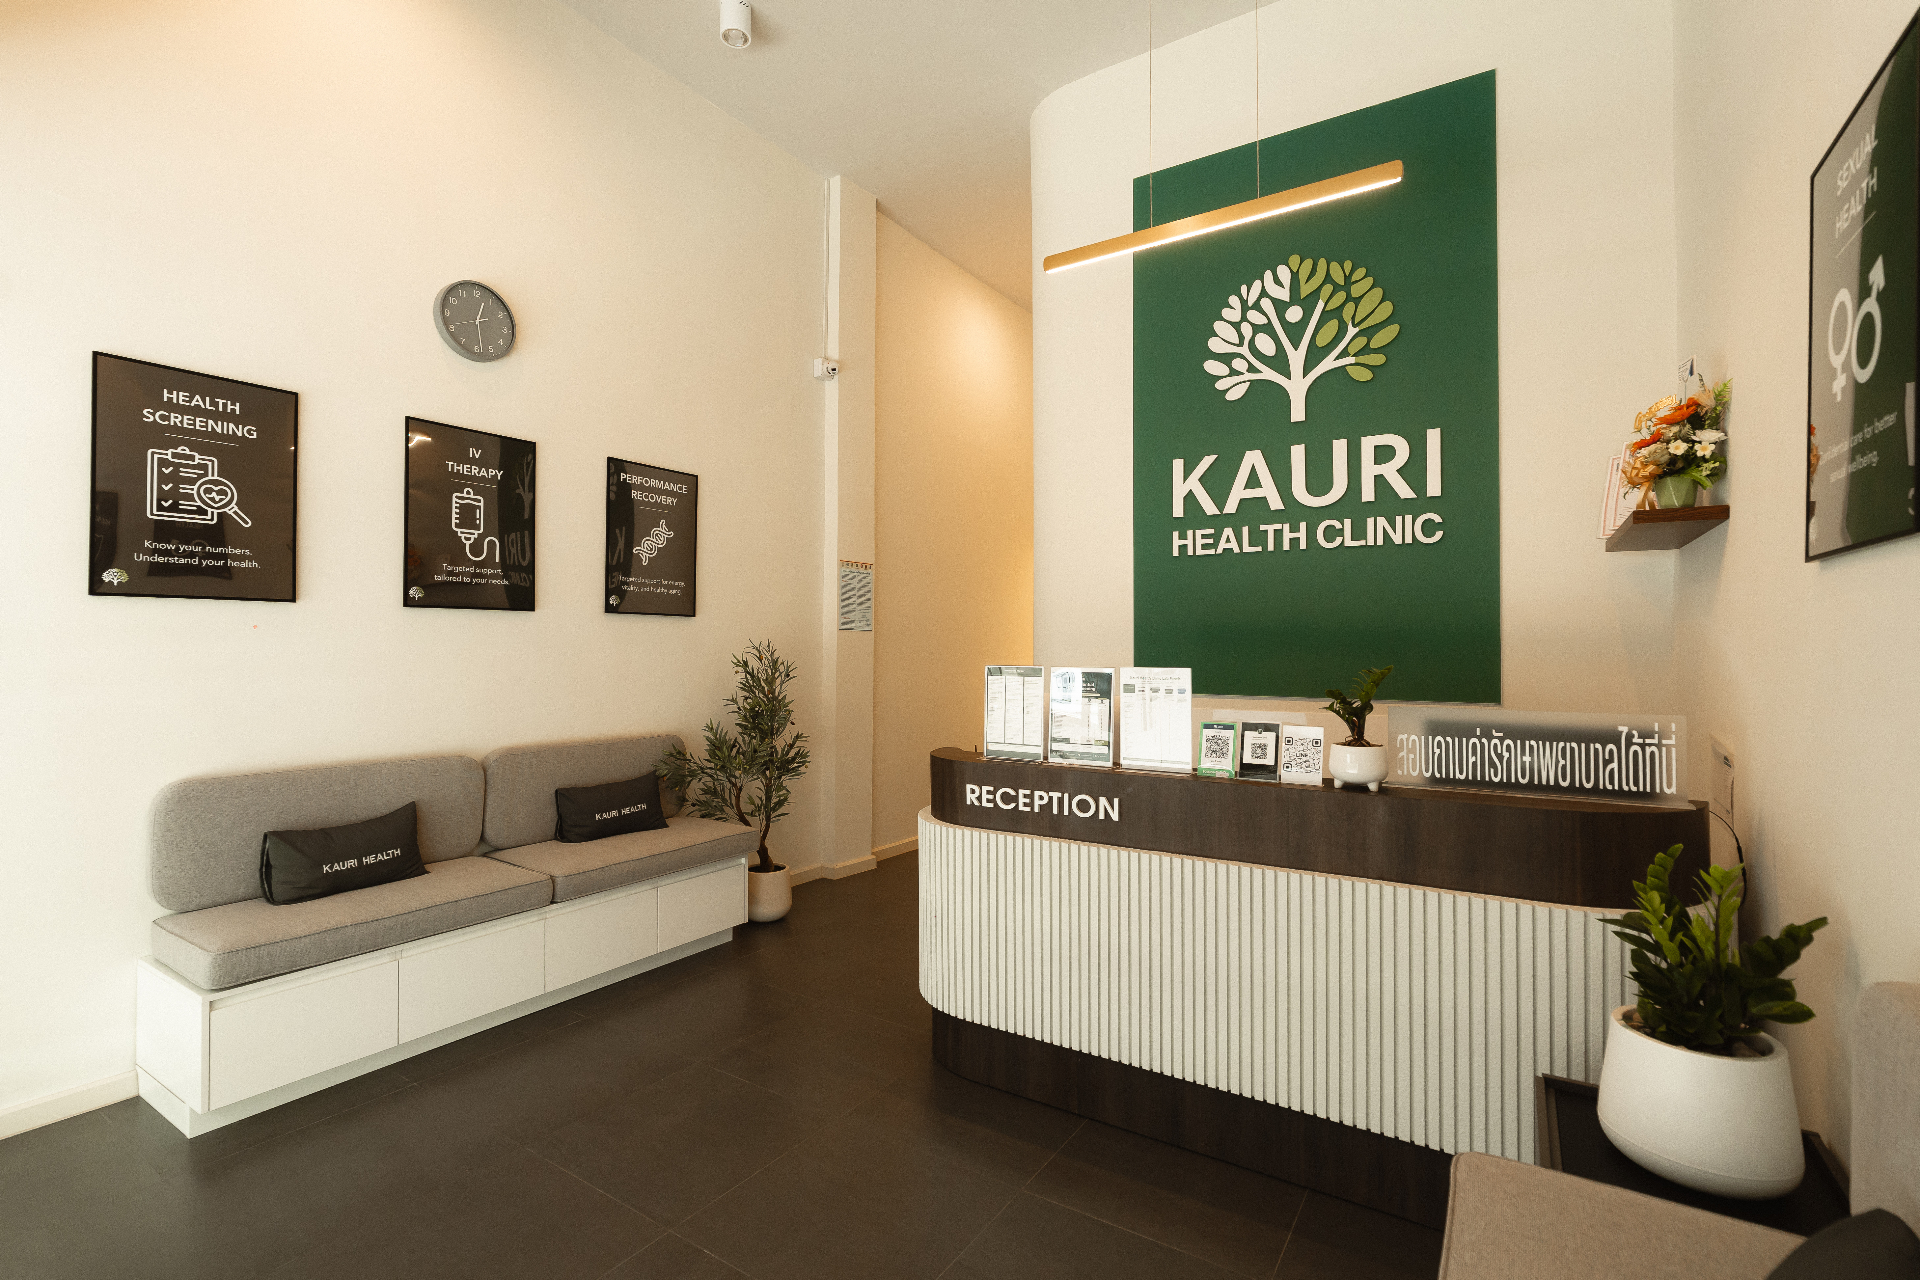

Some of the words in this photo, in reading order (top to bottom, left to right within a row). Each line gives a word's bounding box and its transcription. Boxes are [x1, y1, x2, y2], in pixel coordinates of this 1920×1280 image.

[1836, 123, 1878, 197] SEXUAL
[1835, 166, 1877, 239] HEALTH
[163, 388, 240, 415] HEALTH
[142, 408, 258, 439] SCREENING
[469, 447, 482, 459] IV
[446, 461, 504, 481] THERAPY
[620, 472, 688, 494] PERFORMANCE
[1172, 427, 1442, 518] KAURI
[631, 489, 678, 506] RECOVERY
[1172, 521, 1307, 557] HEALTH
[1316, 512, 1444, 549] CLINIC
[144, 539, 176, 551] Know
[178, 543, 203, 553] your
[205, 545, 253, 556] numbers.
[134, 553, 199, 565] Understand
[201, 558, 225, 568] your
[227, 558, 261, 569] health.
[442, 563, 475, 573] Targeted
[475, 567, 504, 576] support,
[434, 573, 462, 582] tailored
[1396, 722, 1677, 795] สอบถามค่ารักษาพยาบาลได้ที่นี่
[595, 809, 619, 821] KAURI
[621, 802, 647, 816] HEALTH
[965, 783, 1120, 822] RECEPTION
[322, 858, 358, 874] KAURI
[363, 847, 401, 866] HEALTH
